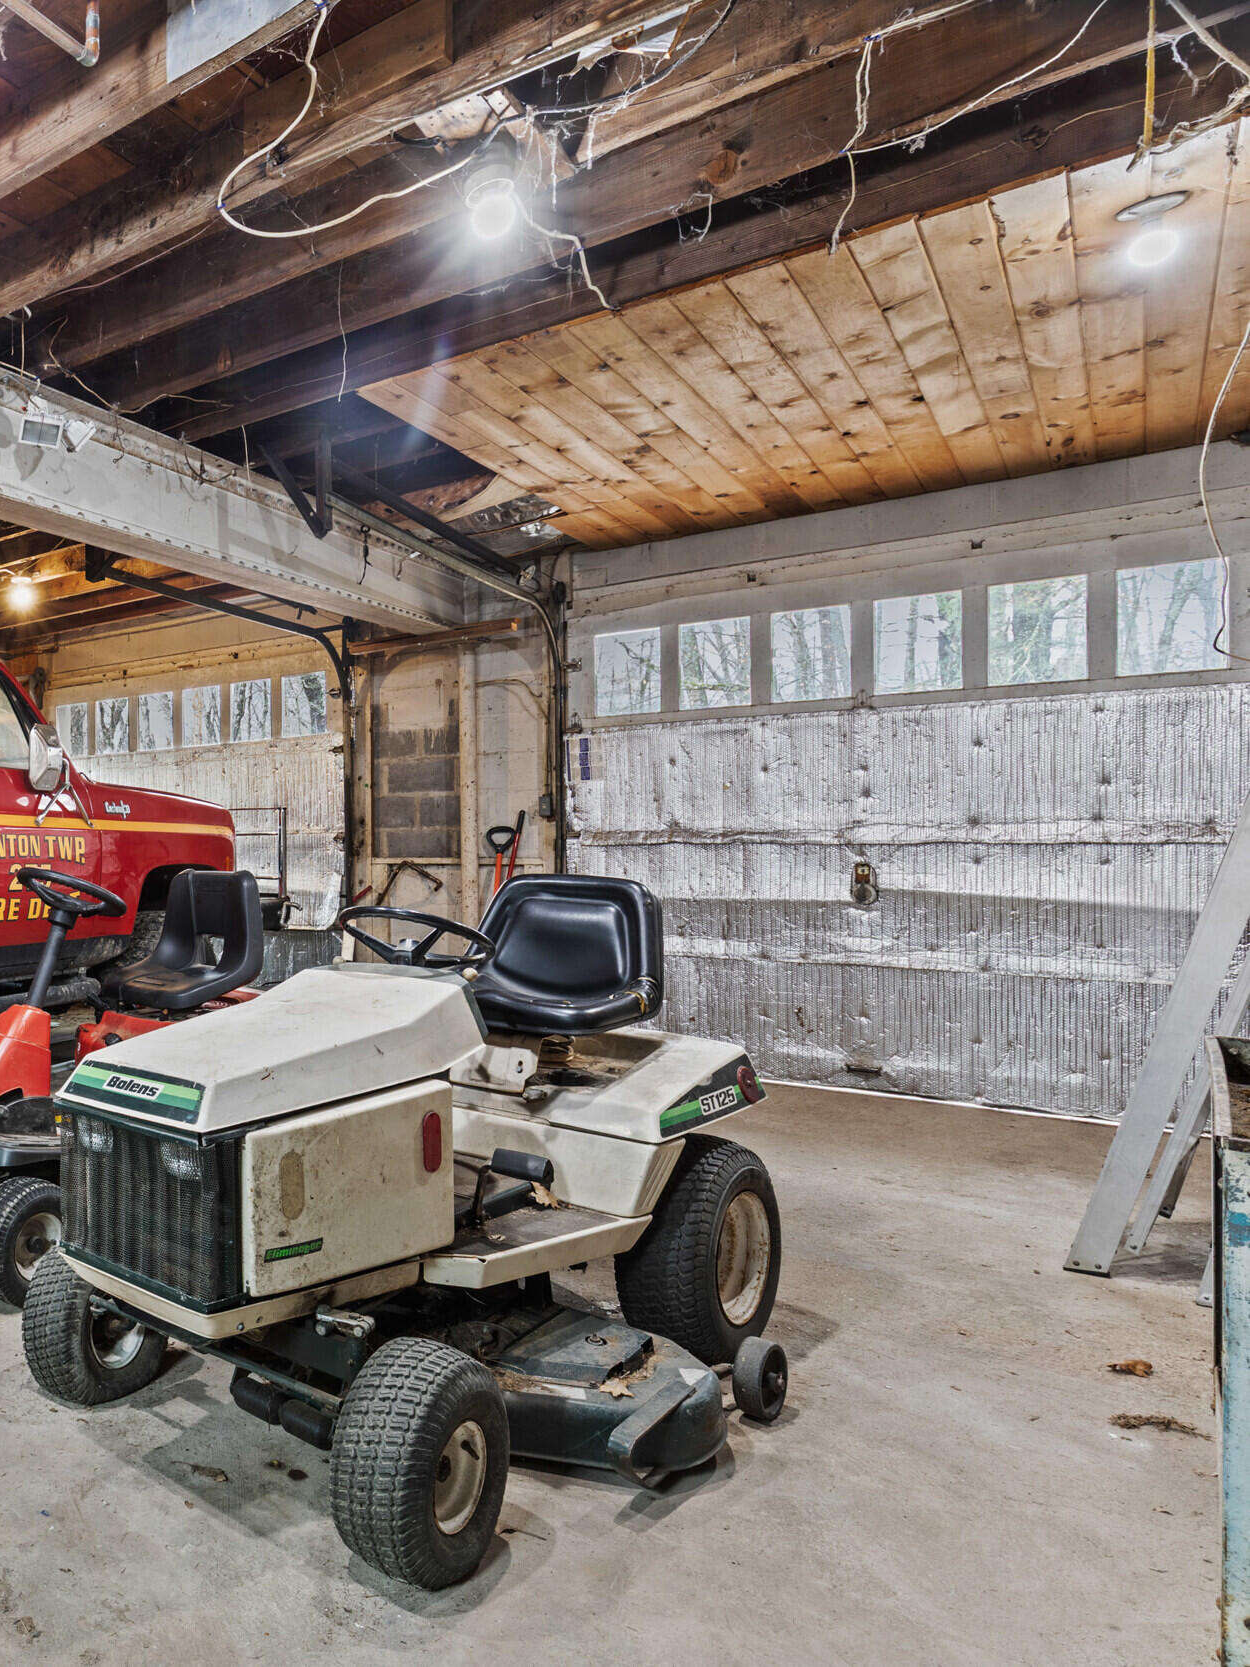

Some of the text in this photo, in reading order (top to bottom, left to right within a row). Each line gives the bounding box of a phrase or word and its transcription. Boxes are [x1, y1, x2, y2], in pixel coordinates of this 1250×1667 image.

[45, 835, 86, 865] TWP.
[106, 1075, 160, 1097] Bolens
[701, 1088, 735, 1113] ST125
